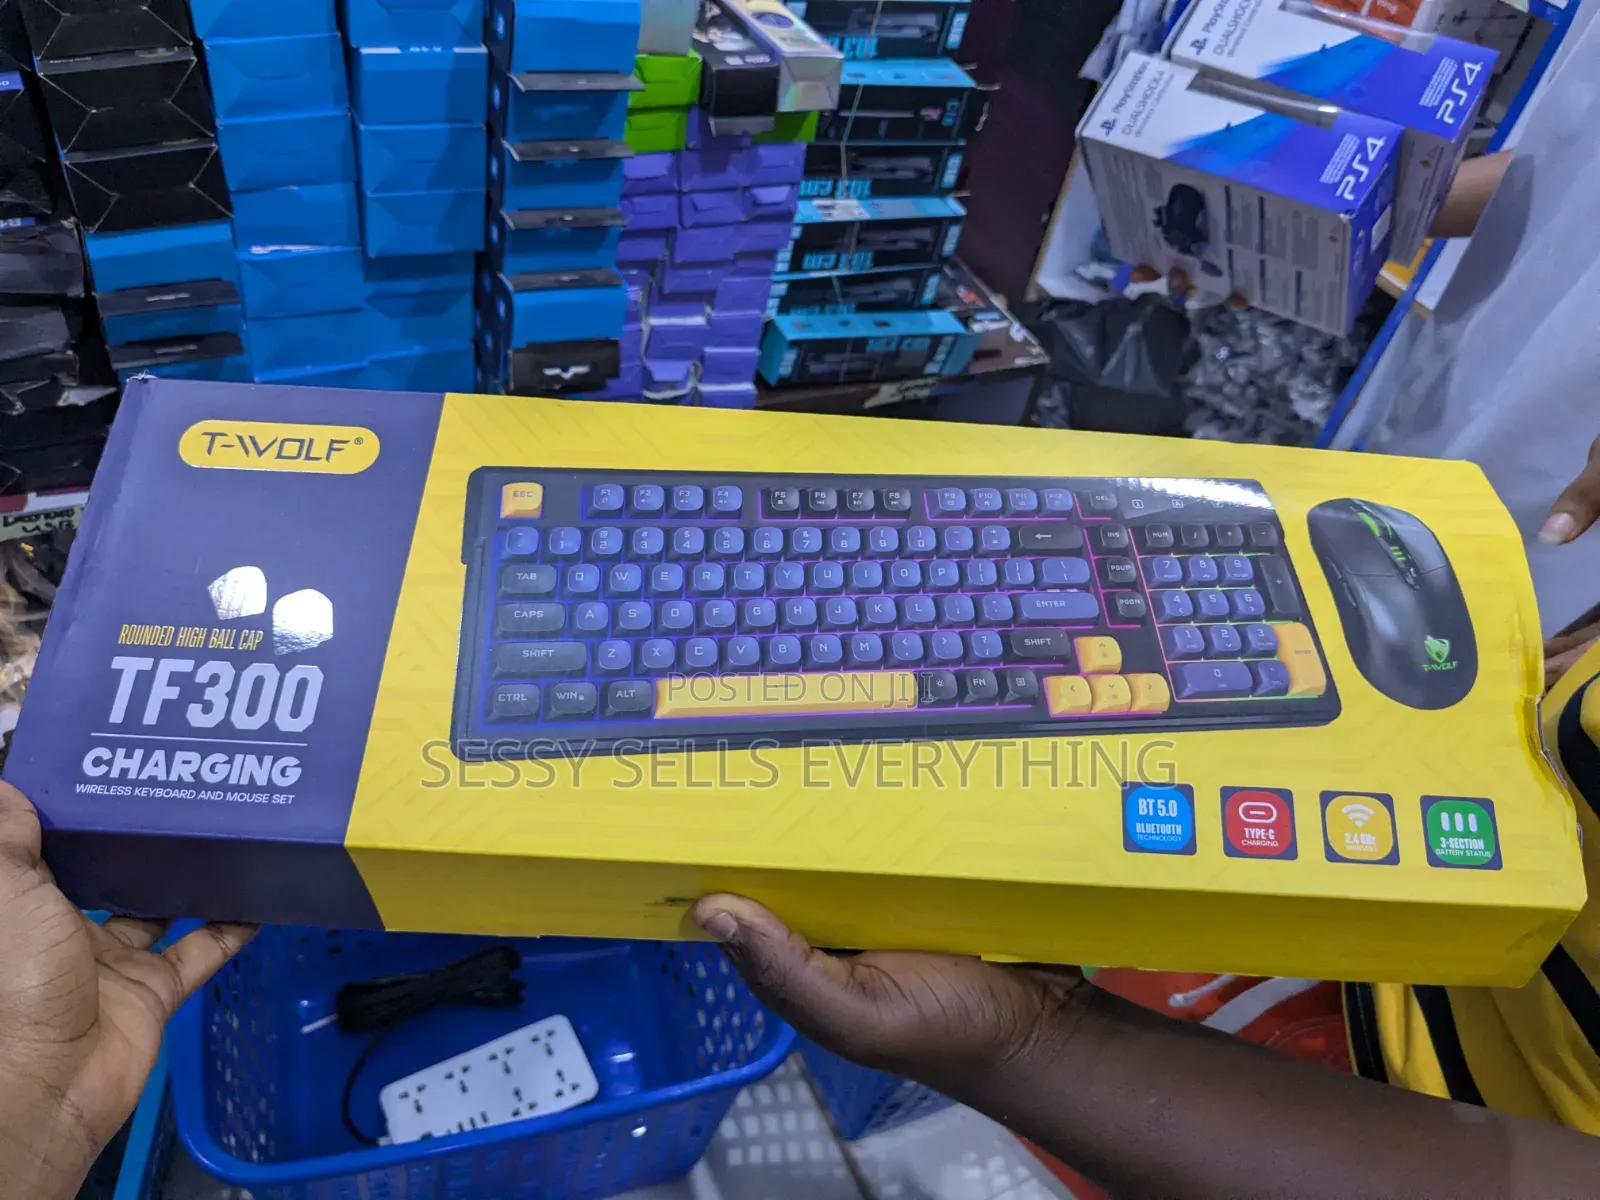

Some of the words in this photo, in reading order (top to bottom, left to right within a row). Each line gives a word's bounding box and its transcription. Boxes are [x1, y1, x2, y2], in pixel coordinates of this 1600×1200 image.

[1111, 61, 1151, 114] PlayStation
[1435, 61, 1484, 124] PS4
[1335, 136, 1387, 201] PS4
[512, 490, 534, 498] ESC
[775, 491, 786, 499] F5
[599, 540, 607, 548] 2
[640, 540, 648, 548] 3
[683, 540, 691, 548] 4
[723, 540, 730, 548] 5
[763, 540, 771, 548] 6
[803, 540, 811, 548] 7
[840, 540, 848, 548] 8
[879, 540, 887, 548] 9
[1163, 560, 1171, 568] 7
[516, 572, 537, 580] TAB
[575, 572, 584, 581] Q
[615, 572, 629, 581] W
[660, 572, 668, 580] E
[703, 571, 711, 580] R
[743, 571, 751, 580] T
[783, 571, 791, 579] Y
[824, 570, 832, 579] U
[900, 569, 908, 577] O
[938, 568, 946, 577] P
[915, 604, 922, 612] L
[1036, 600, 1066, 608] ENTER
[628, 609, 637, 617] S
[671, 609, 679, 617] D
[713, 608, 720, 616] F
[752, 607, 761, 615] G
[794, 607, 802, 615] H
[834, 606, 842, 614] J
[875, 605, 882, 613] K
[513, 610, 544, 618] CAPS
[584, 610, 595, 618] A
[1257, 629, 1264, 637] 3
[118, 624, 175, 647] ROUNDED
[176, 626, 207, 648] HIGH
[208, 628, 235, 650] BALL
[238, 629, 264, 651] CAP
[1024, 638, 1052, 646] SHIFT
[736, 645, 746, 654] V
[779, 644, 787, 653] B
[819, 643, 828, 652] N
[860, 642, 869, 651] M
[522, 649, 554, 658] SHIFT
[608, 649, 616, 658] Z
[652, 648, 661, 657] X
[694, 647, 703, 655] C
[1421, 660, 1459, 672] T-WOLF
[1214, 668, 1222, 677] 0
[108, 656, 325, 733] TF300
[498, 693, 527, 702] CTRL
[556, 691, 578, 700] WIN
[615, 689, 635, 698] ALT
[82, 747, 302, 787] CHARGING
[75, 783, 132, 796] WIRELESS
[133, 787, 196, 800] KEYBOARD
[197, 790, 224, 801] AND
[226, 792, 270, 803] MOUSE
[271, 794, 295, 805] SET
[1138, 798, 1155, 816] BT
[1157, 799, 1178, 817] 5.0
[1136, 823, 1182, 835] BLUETOOTH
[1244, 827, 1275, 840] TYPE-C
[1137, 834, 1182, 842] TECHNOLOGY
[1241, 839, 1279, 847] CHARGING
[1440, 837, 1484, 850] 3-SECTION
[1435, 848, 1464, 857] BATTERY
[1466, 850, 1492, 858] STATUS
